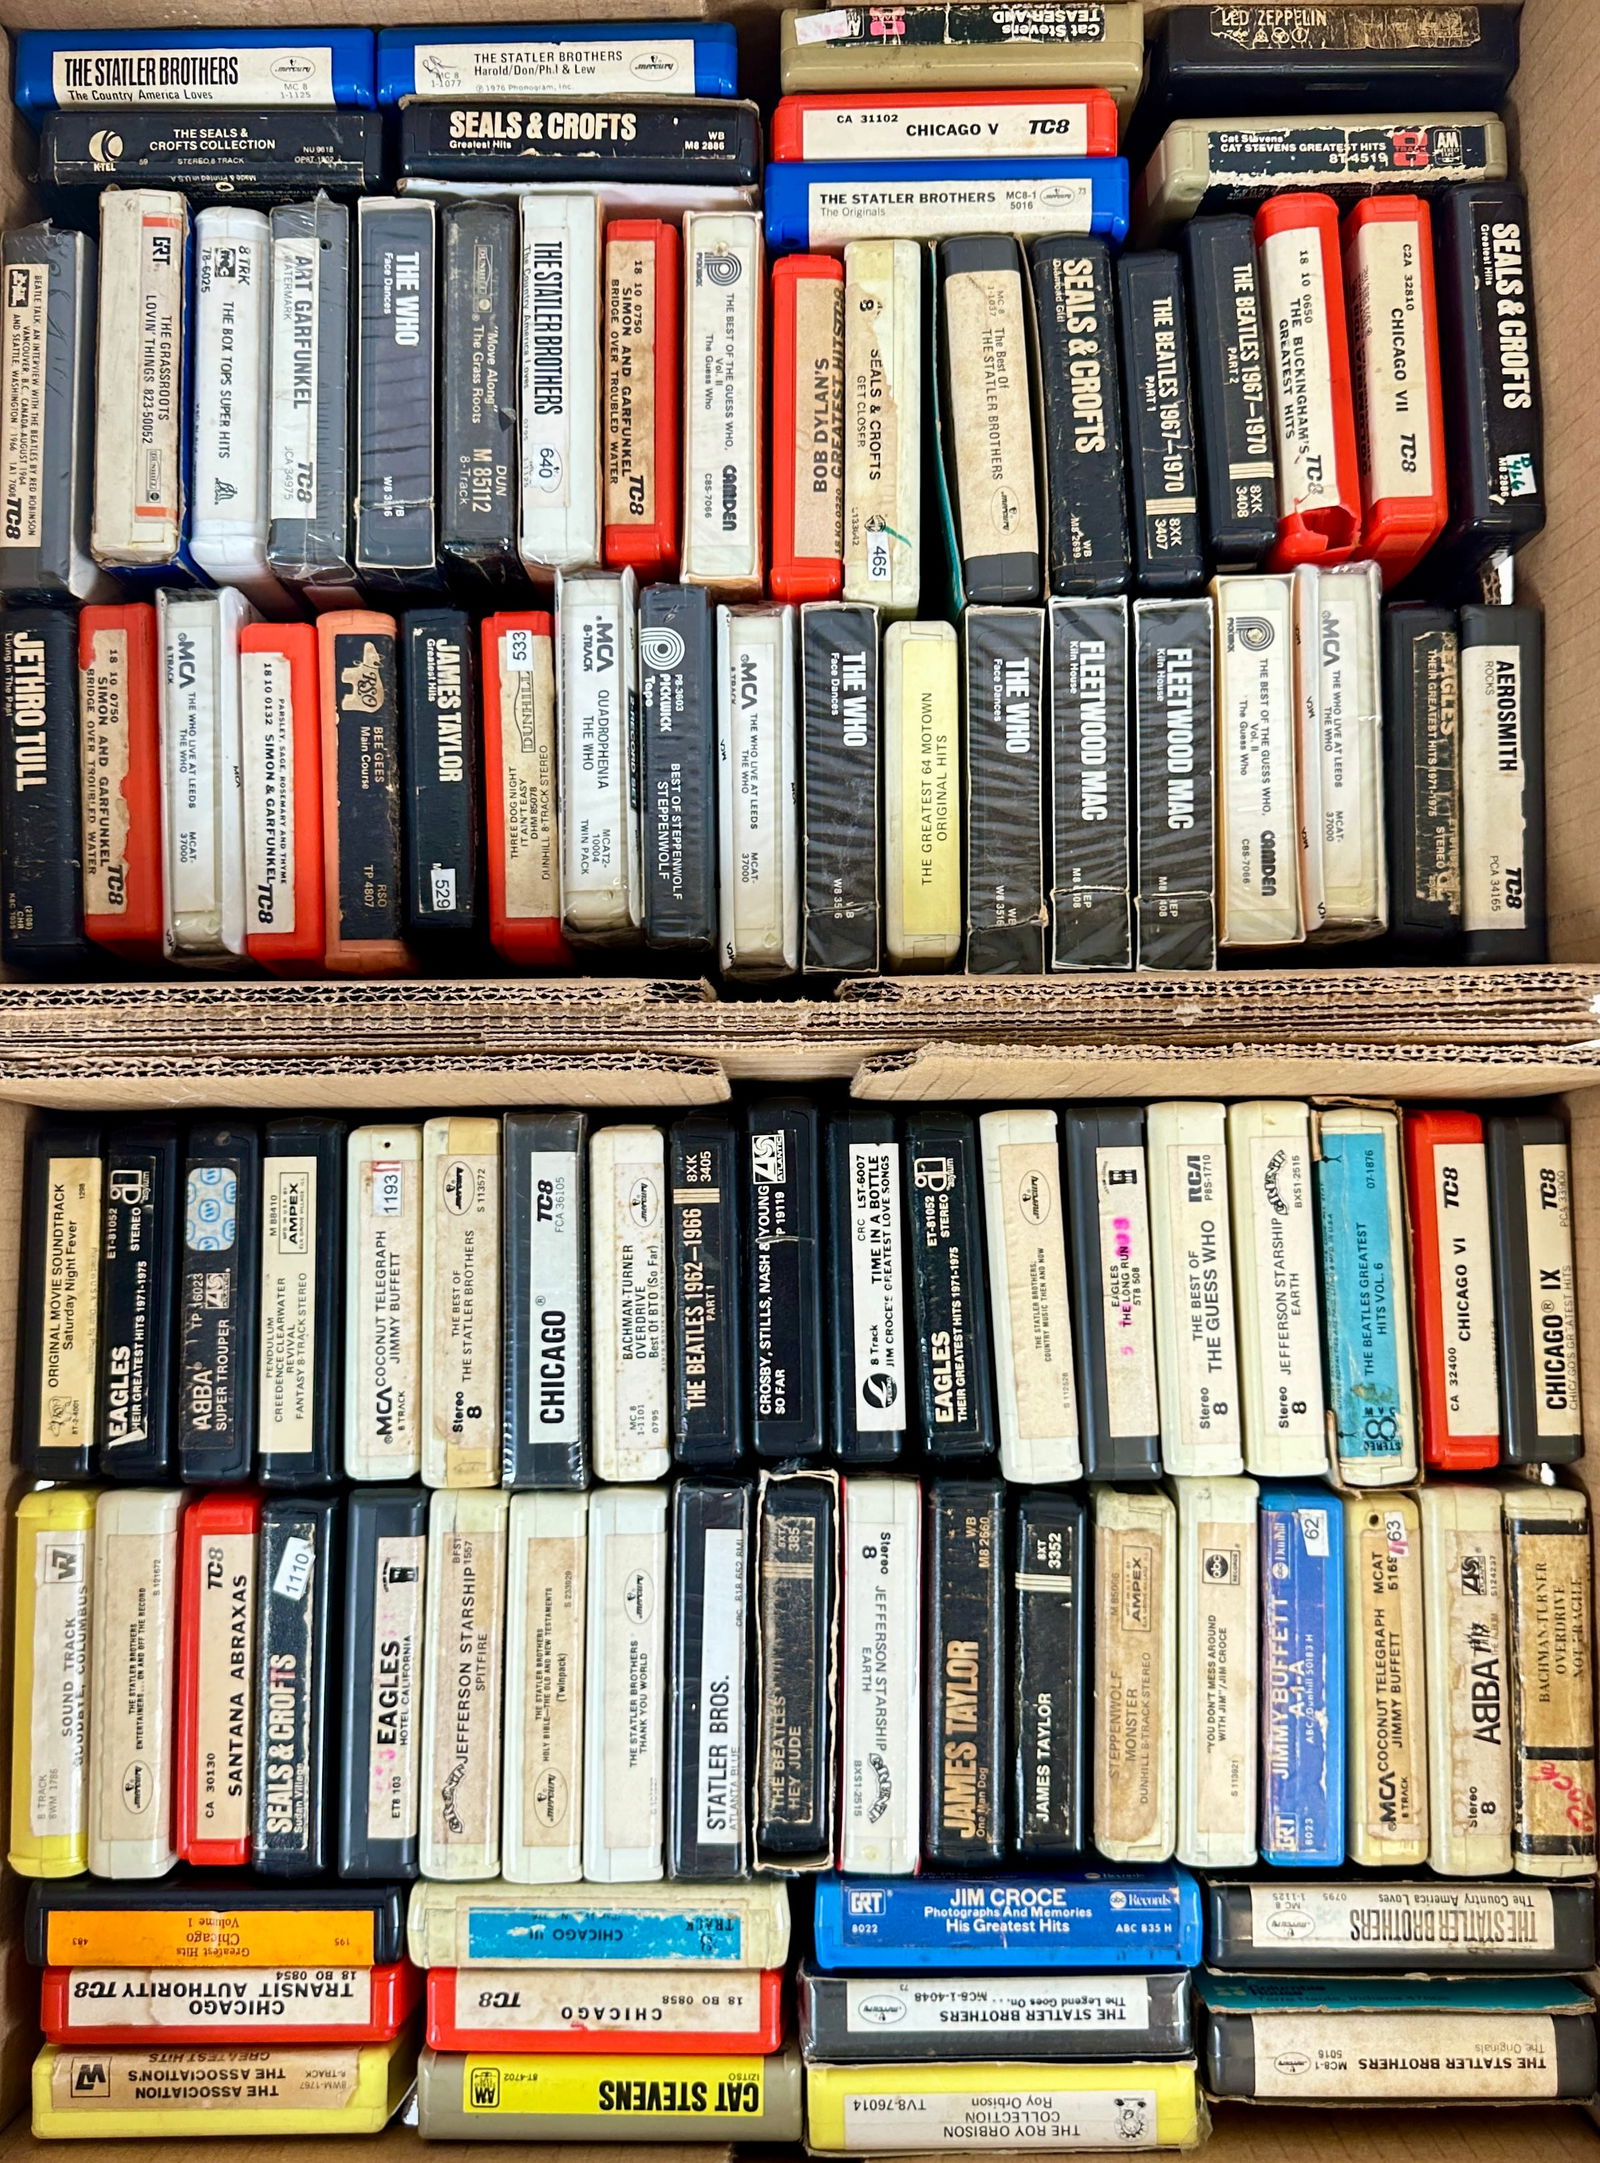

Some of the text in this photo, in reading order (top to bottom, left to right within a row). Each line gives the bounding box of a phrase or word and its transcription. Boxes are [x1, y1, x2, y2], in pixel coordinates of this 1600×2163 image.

[64, 56, 238, 87] THE STATLER BROTHERS
[67, 89, 214, 102] The Country America Loves
[450, 111, 636, 140] SEALS & CROFTS
[837, 114, 898, 123] CA 31102
[906, 119, 1070, 136] CHICAGO V TC8
[820, 194, 847, 204] THE
[852, 193, 914, 204] STATLER
[919, 192, 996, 203] BROTHERS
[1010, 201, 1033, 210] 5016
[143, 338, 155, 382] THINGS
[534, 241, 563, 415] THE STATLER BROTHERS
[158, 316, 172, 420] THE GRASSROOTS
[218, 302, 234, 458] THE BOX TOPS SUPER HITS
[293, 255, 313, 504] ART GARFUNKEL TC8
[621, 287, 632, 477] SIMON AND GARFUNKEL
[1391, 308, 1416, 473] CHICAGO VII TC8
[142, 389, 154, 444] 823-50052
[538, 448, 554, 478] 640
[629, 475, 644, 516] TC8
[722, 465, 737, 531] CAMDEN
[1155, 519, 1168, 550] 3407
[1169, 518, 1182, 546] 8XK
[1157, 648, 1166, 702] Kiln House
[13, 632, 50, 791] JETHRO TULL
[436, 639, 463, 781] JAMES TAYLOR
[597, 690, 610, 789] QUADROPHENIA
[1167, 648, 1194, 829] FLEETWOOD MAC
[361, 727, 371, 789] Main Course
[373, 727, 385, 783] BEE GEES
[583, 715, 594, 771] THE WHO
[741, 659, 758, 829] MCA THE WHO LIVE AT LEEDS
[921, 693, 932, 886] THE GREATEST 64 MOTOWN
[936, 735, 947, 841] ORIGINAL HITS
[1485, 661, 1501, 912] ROCKS PCA 34165
[1496, 661, 1522, 909] AEROSMITH TC8
[258, 734, 277, 924] SIMON & GARFUNKEL TC8
[657, 781, 670, 879] STEPPENWOLF
[671, 763, 683, 900] BEST OF STEPPENWOLF
[435, 879, 451, 909] 529
[383, 1175, 398, 1213] 1193
[554, 1177, 565, 1233] FCA 36105
[1187, 1155, 1202, 1202] RCA
[48, 1184, 65, 1388] ORIGINAL MOVIE SOUNDTRACK
[62, 1220, 78, 1350] Saturday Night Fever
[1443, 1167, 1471, 1341] CHICAGO VI TC8
[375, 1231, 386, 1387] COCONUT TELEGRAPH
[389, 1252, 400, 1364] JIMMY BUFFETT
[537, 1180, 566, 1424] CHICAGO TC8
[1200, 1220, 1222, 1373] THE GUESS WHO
[216, 1320, 229, 1431] SUPER TROUPER
[775, 1369, 785, 1414] SO FAR
[931, 1331, 954, 1422] EAGLES
[1448, 1347, 1460, 1411] CA 32400
[1048, 1533, 1061, 1569] 3352
[1304, 1517, 1319, 1540] 62
[228, 1575, 247, 1796] SANTANA ABRAXAS
[456, 1567, 476, 1764] JEFFERSON STARSHIP
[475, 1634, 488, 1691] SPITFIRE
[265, 1651, 296, 1833] SEALS & CROFTS
[706, 1676, 729, 1830] STATLER BROS.
[1036, 1693, 1051, 1822] JAMES TAYLOR
[205, 1753, 215, 1818] CA 30130
[950, 1888, 1067, 1907] JIM CROCE
[479, 1992, 744, 2008] 18 BO 0858 TC8
[561, 2007, 662, 2021] CHICAGO
[599, 2080, 759, 2112] CAT STEVENS
[965, 2111, 1060, 2124] COLLECTION
[944, 2125, 1080, 2138] THE ROY ORBISON
